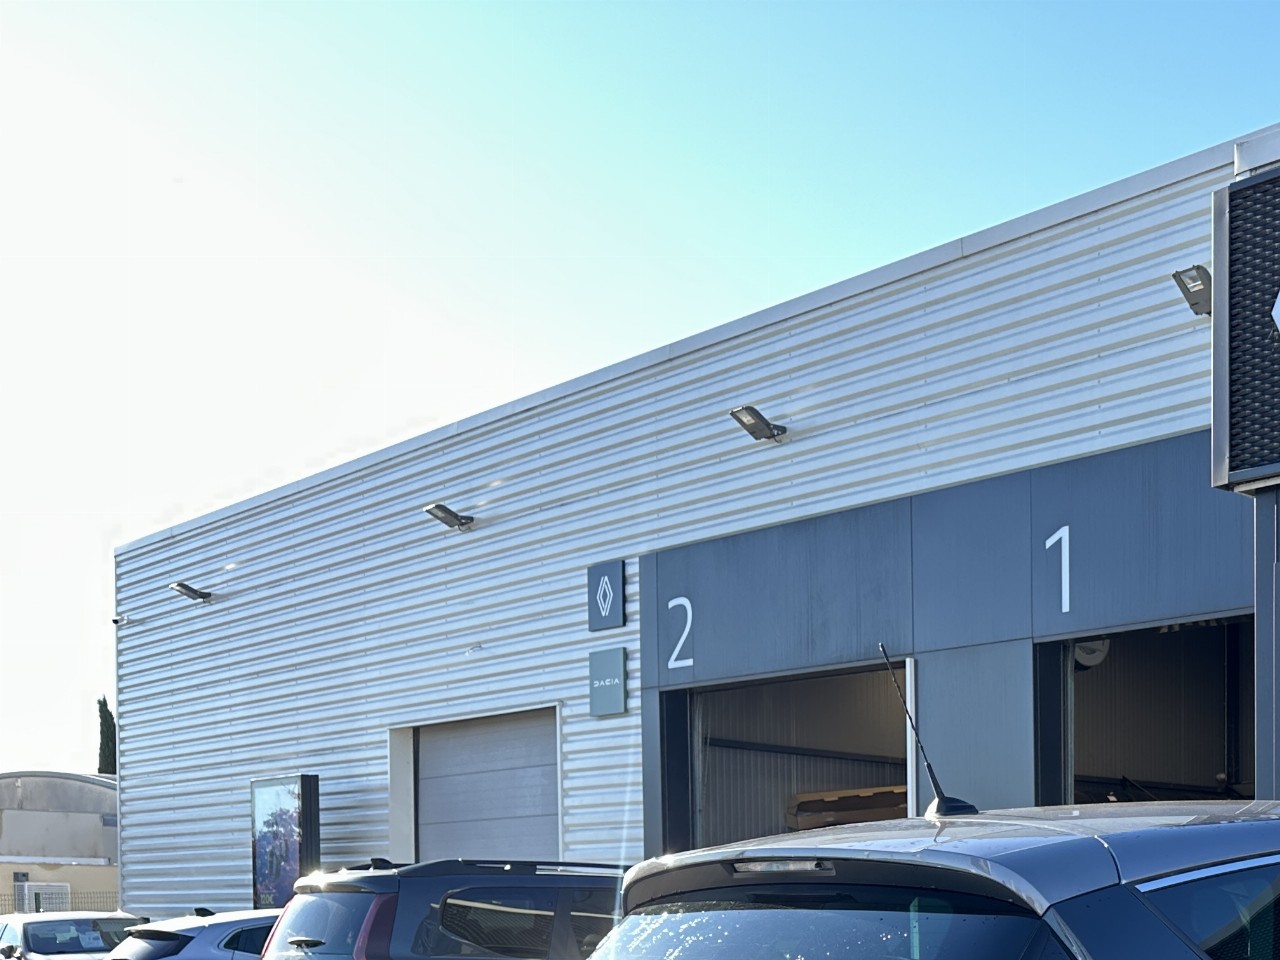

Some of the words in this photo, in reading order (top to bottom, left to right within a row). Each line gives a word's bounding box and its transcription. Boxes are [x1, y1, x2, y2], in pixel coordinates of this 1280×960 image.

[1044, 525, 1070, 613] 1
[667, 596, 694, 669] 2
[593, 678, 620, 688] DACIA
